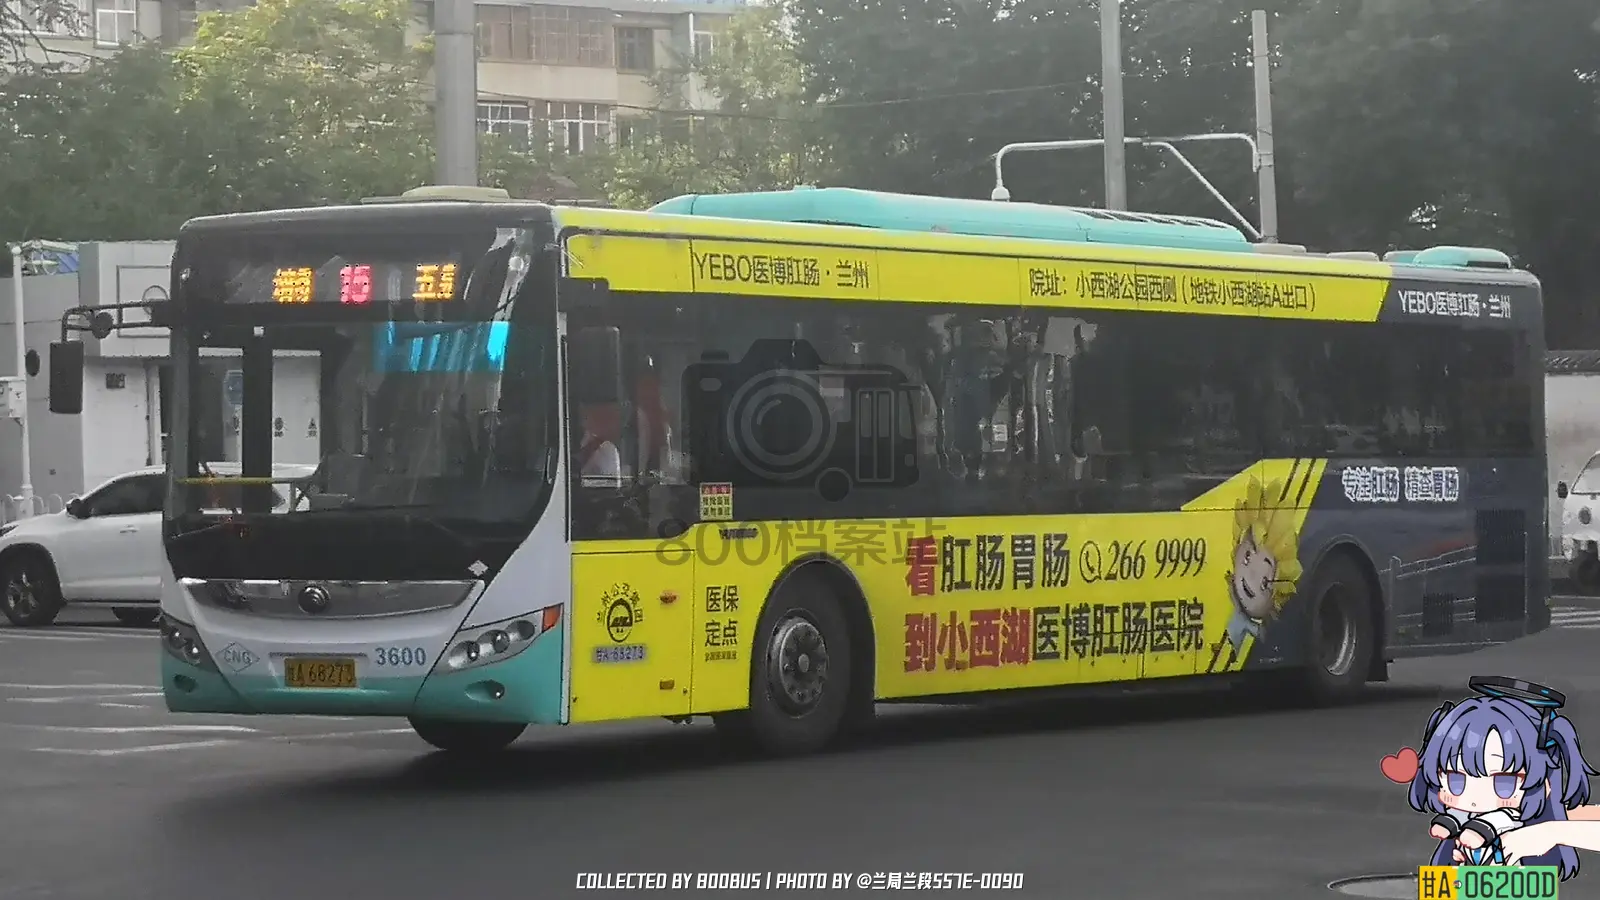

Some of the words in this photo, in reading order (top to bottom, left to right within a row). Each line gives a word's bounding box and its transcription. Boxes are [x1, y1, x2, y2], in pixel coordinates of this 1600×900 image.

[906, 533, 1071, 597] 看肛肠胃肠
[1104, 540, 1147, 581] 266
[1154, 537, 1207, 579] 9999
[706, 585, 740, 613] 医保
[704, 618, 738, 647] 定点
[904, 596, 1205, 672] 到小西湖医博肛肠医院
[223, 648, 254, 665] CNG
[374, 646, 428, 667] 3600
